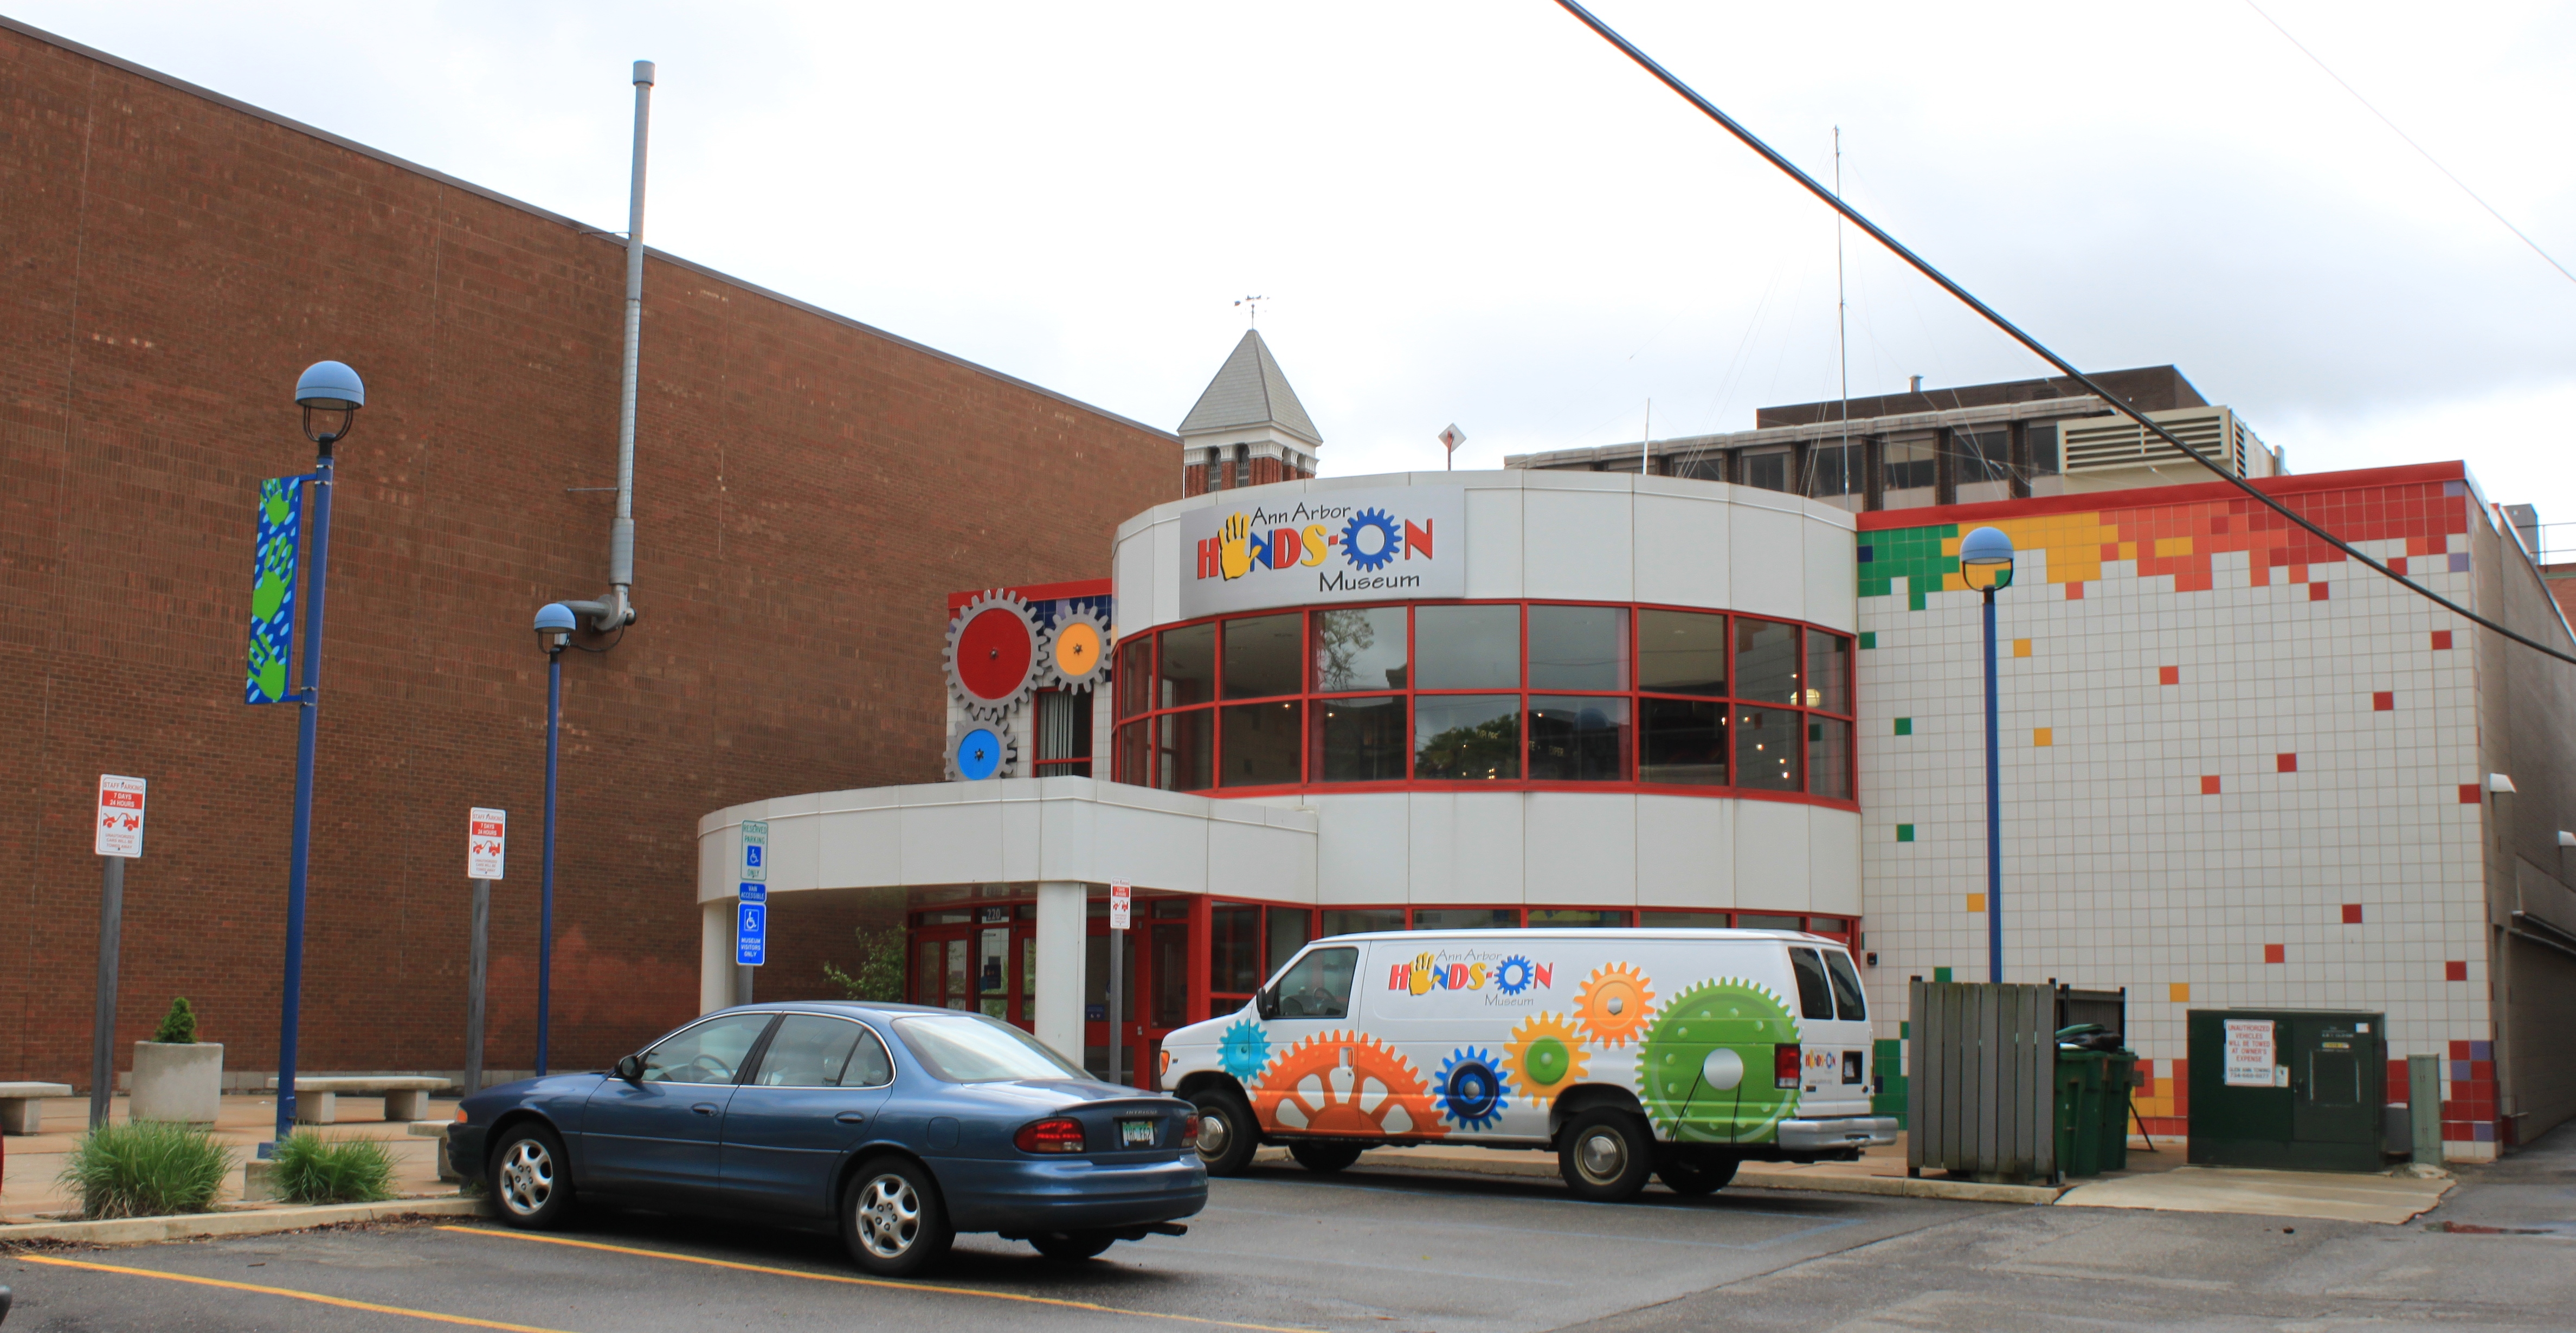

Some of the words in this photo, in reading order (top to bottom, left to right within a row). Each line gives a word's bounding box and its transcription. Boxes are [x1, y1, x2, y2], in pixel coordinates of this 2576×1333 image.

[1251, 506, 1288, 526] Ann
[1292, 502, 1352, 521] Arbor
[1319, 570, 1420, 592] Museum
[117, 800, 134, 808] HOURS
[743, 825, 767, 834] RESERVED
[744, 835, 765, 845] PARKING
[747, 868, 760, 877] ONLY
[740, 892, 764, 900] ACCESSIBLE
[987, 908, 1001, 920] 220
[1435, 949, 1462, 962] Ann
[1464, 949, 1502, 961] Arbor
[1484, 993, 1534, 1007] Museum
